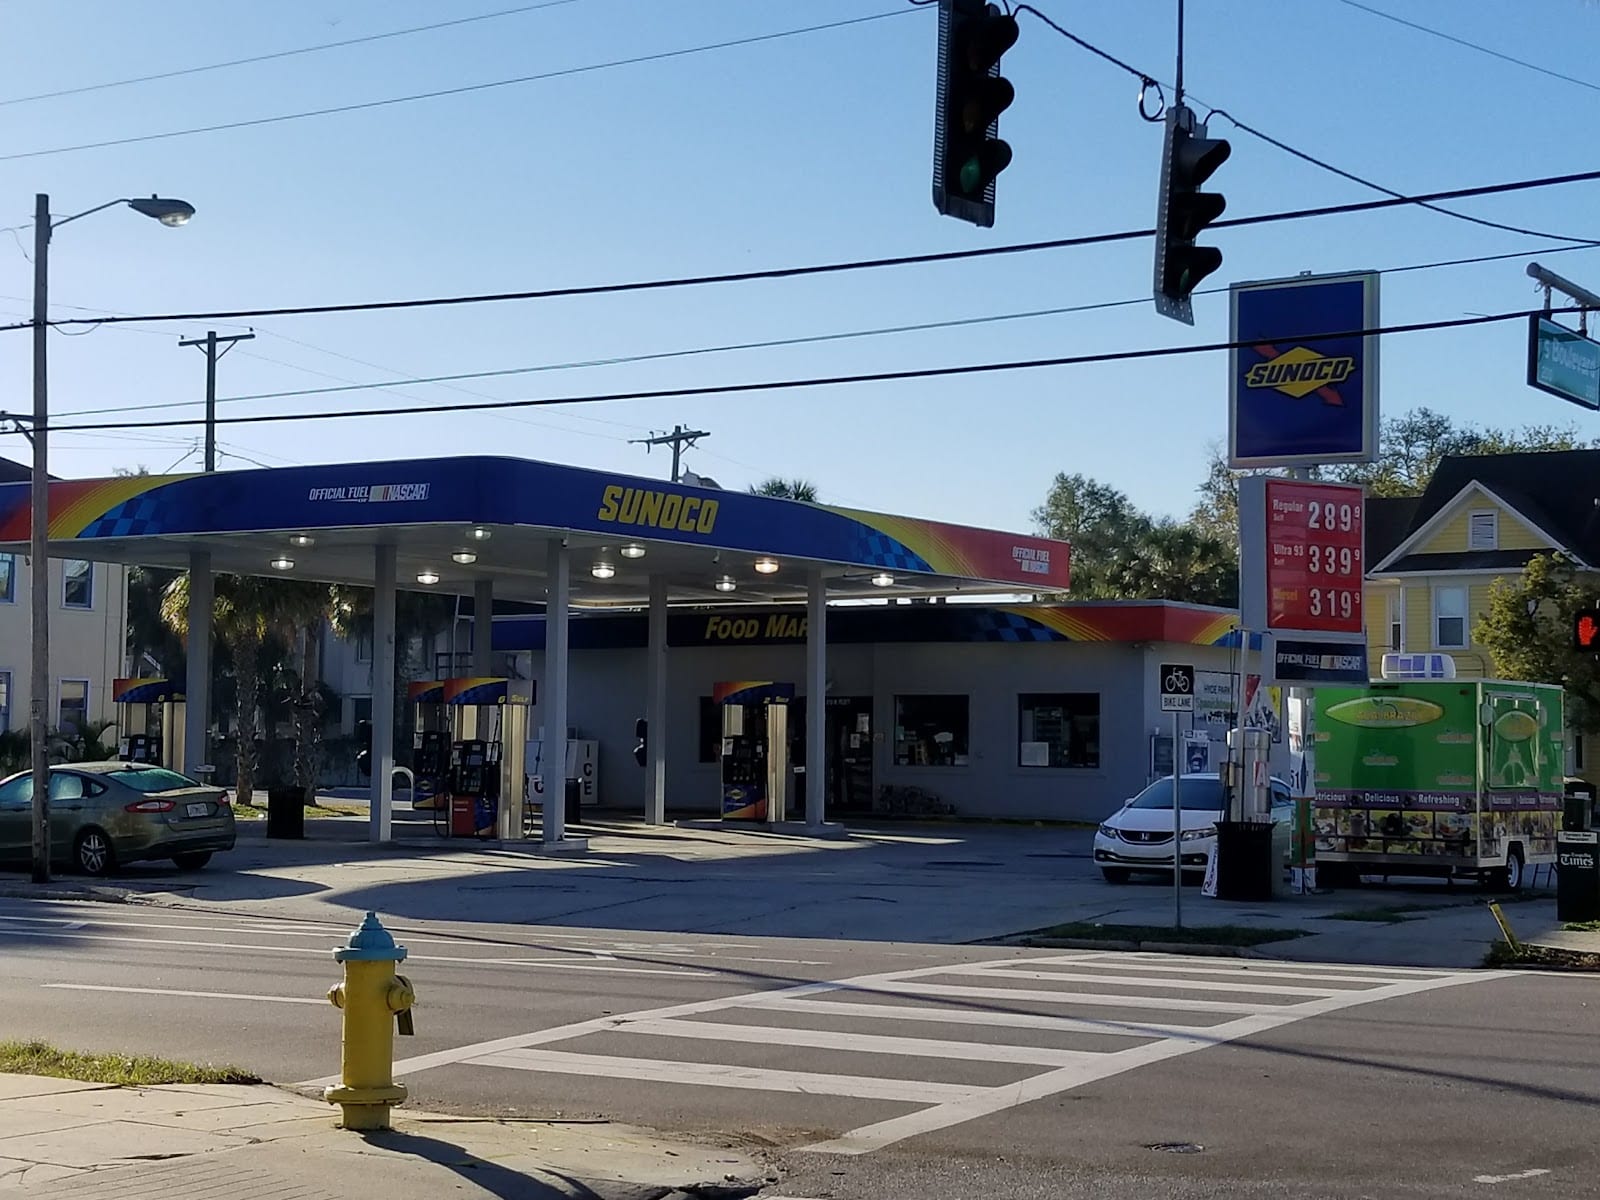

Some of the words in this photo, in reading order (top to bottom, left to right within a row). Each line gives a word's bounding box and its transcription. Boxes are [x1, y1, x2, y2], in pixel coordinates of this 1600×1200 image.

[1249, 360, 1350, 385] SUNOCO
[308, 487, 346, 501] OFFICIAL
[348, 486, 369, 498] FUEL
[389, 484, 429, 501] NASCAR
[598, 485, 719, 534] SUNOCO
[1272, 499, 1304, 513] Regular
[1273, 544, 1292, 555] Ultra
[1293, 545, 1304, 556] 93
[704, 615, 760, 640] FOOD
[764, 613, 808, 638] MAR
[1276, 653, 1303, 664] OFFICIAL
[1305, 654, 1319, 664] FUEL
[1164, 697, 1177, 706] BIKE
[1177, 697, 1191, 707] LANE
[1364, 793, 1400, 803] Delicious
[1418, 794, 1460, 807] Refreshing
[1560, 853, 1594, 866] Times
